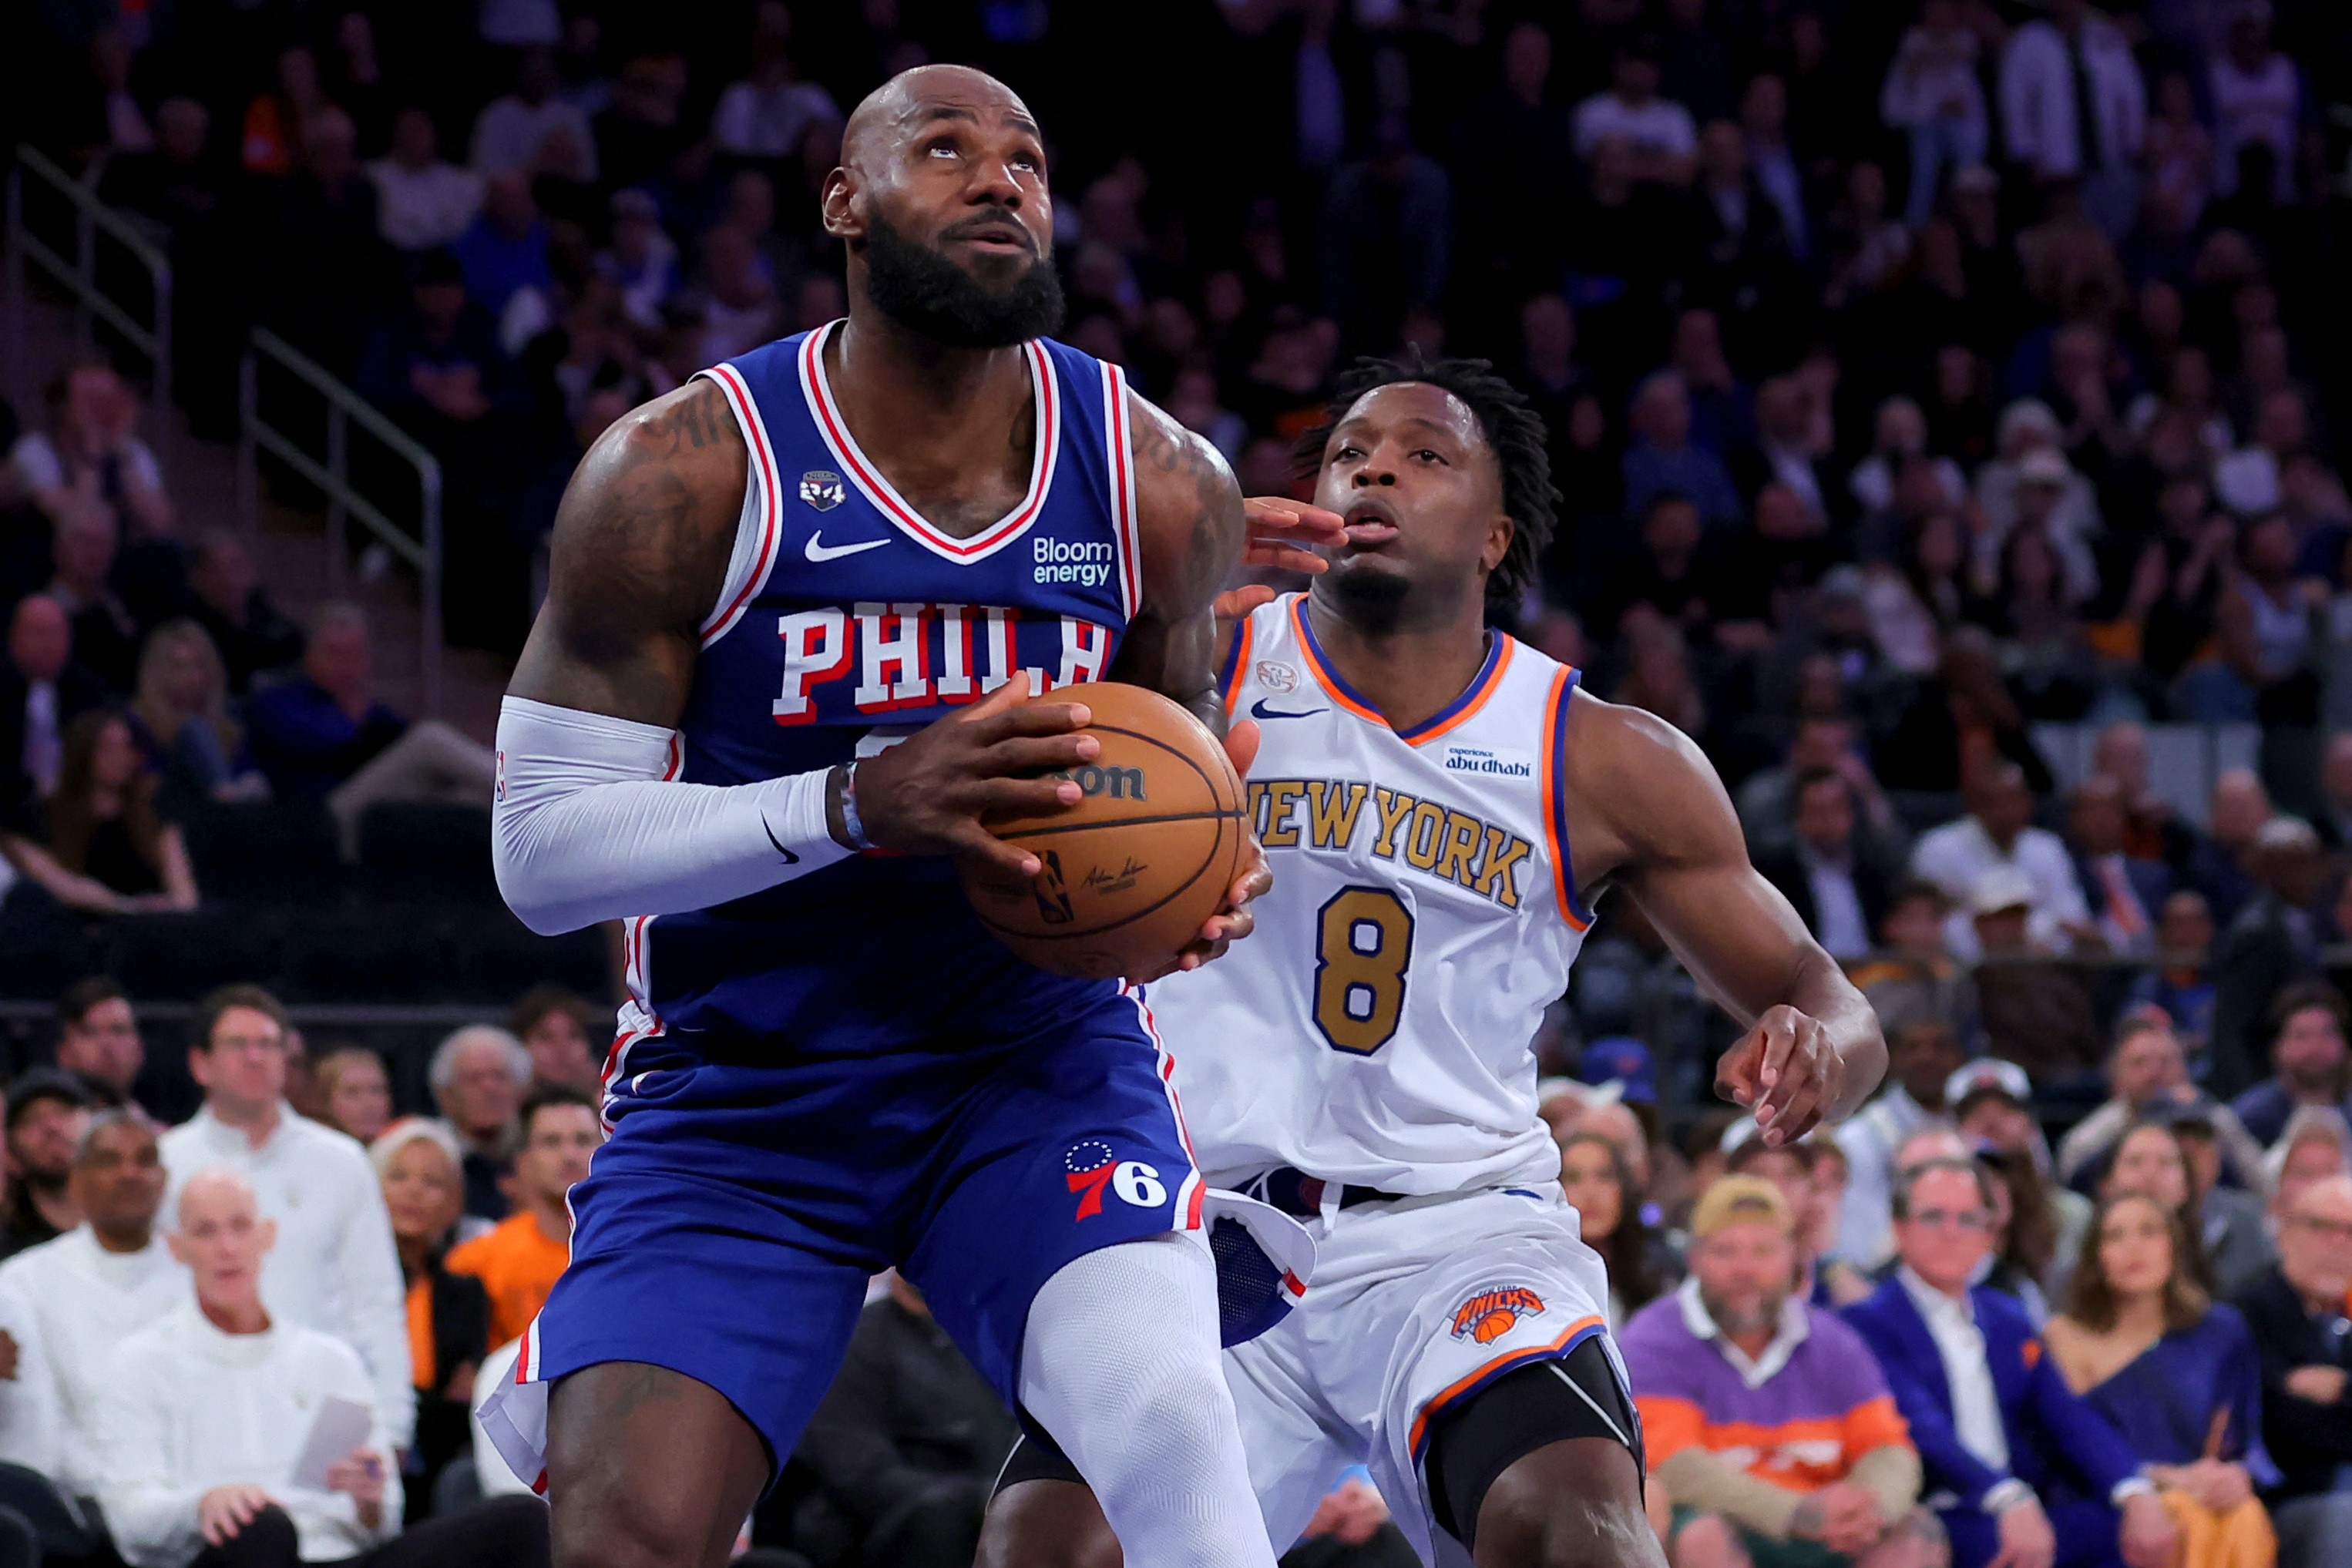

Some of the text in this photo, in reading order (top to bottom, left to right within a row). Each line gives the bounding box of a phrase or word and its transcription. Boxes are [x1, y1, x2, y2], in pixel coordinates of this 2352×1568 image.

[1033, 537, 1113, 563] Bloom
[1033, 564, 1110, 586] energy
[1446, 756, 1531, 777] abu dhabi
[1449, 747, 1494, 757] experience
[1372, 784, 1532, 911] YORK
[1312, 885, 1416, 1057] 8
[1066, 1160, 1168, 1222] 76
[1450, 1288, 1546, 1337] KNICKS
